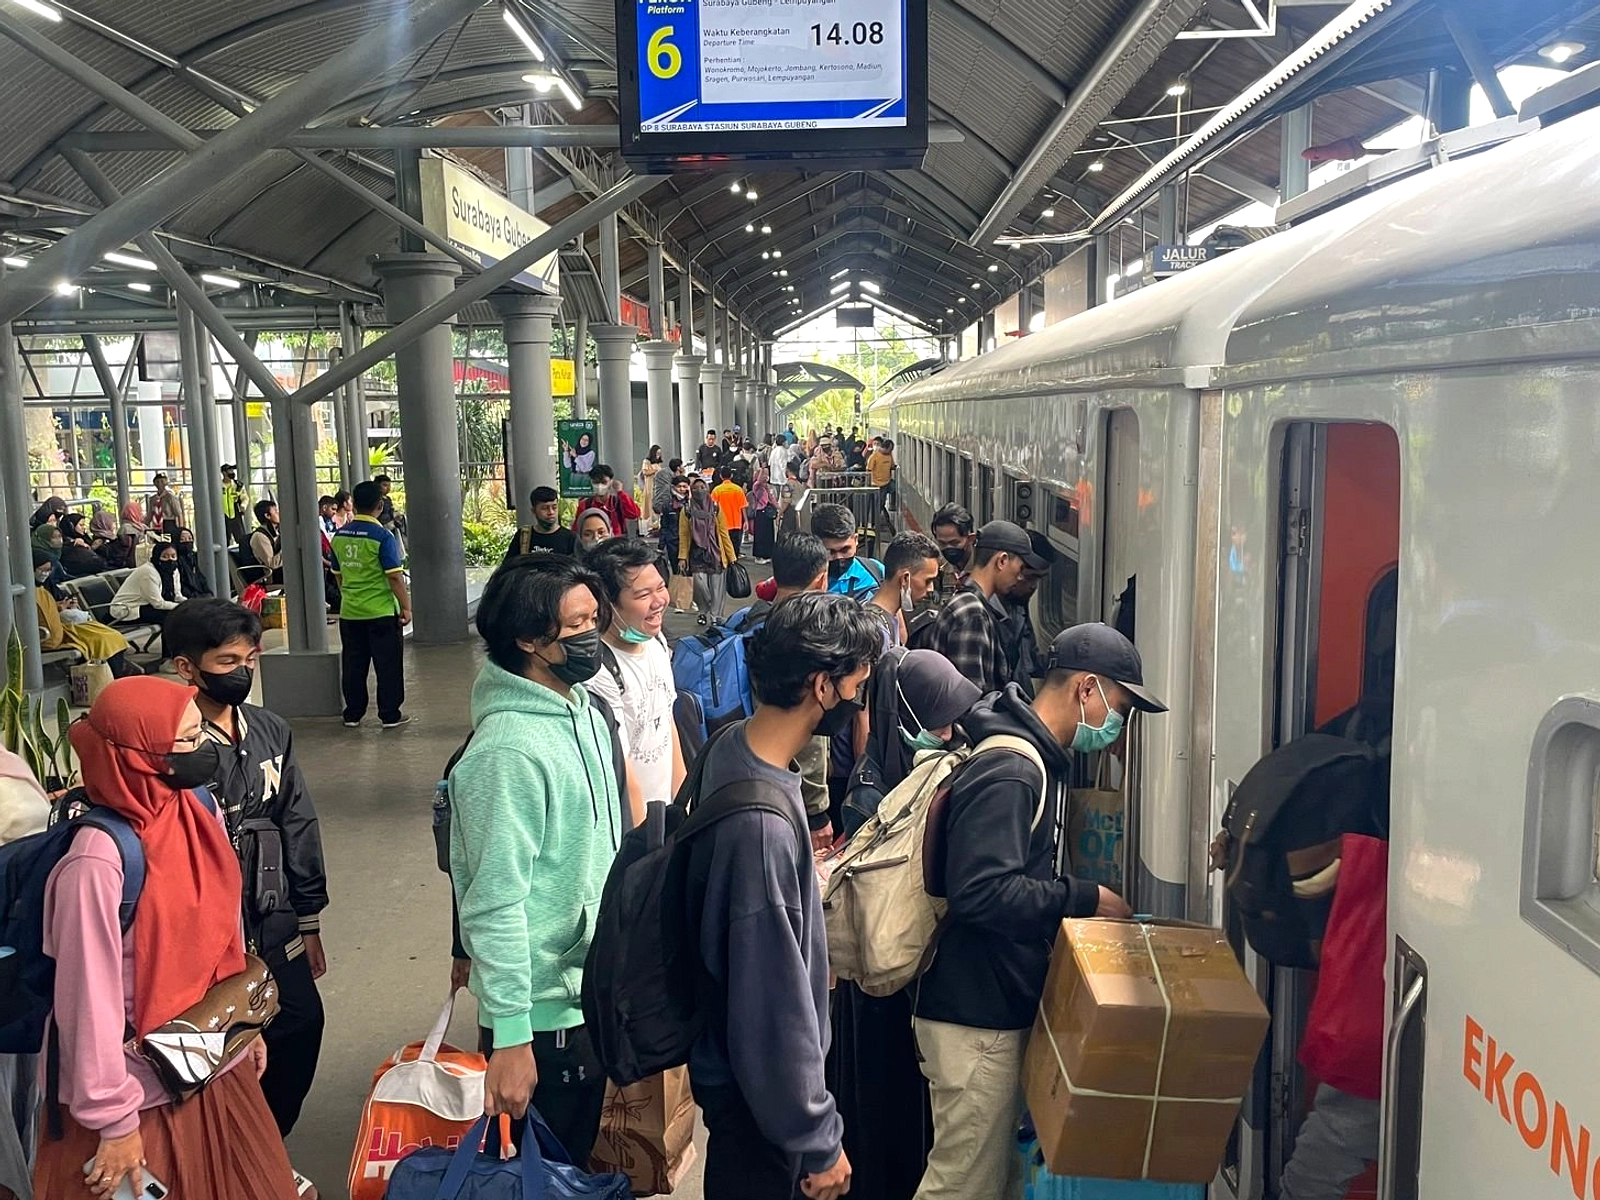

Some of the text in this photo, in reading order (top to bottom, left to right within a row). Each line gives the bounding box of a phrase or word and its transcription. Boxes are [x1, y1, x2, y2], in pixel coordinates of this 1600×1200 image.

[647, 5, 685, 14] Platform
[703, 27, 790, 37] Waktu Keberangkatan
[811, 21, 884, 46] 14.08
[703, 38, 755, 47] Departure Time
[646, 25, 682, 79] 6
[747, 65, 783, 73] Mojokerto,
[819, 63, 855, 71] Kertosono,
[705, 75, 730, 83] Sragen,
[768, 74, 815, 82] Lempuyangan
[661, 123, 702, 131] SURABAYA
[451, 185, 531, 248] Surabaya Gube
[1162, 247, 1207, 260] JALUR
[345, 544, 358, 559] 37
[260, 754, 284, 802] N
[1463, 1013, 1600, 1200] EKON
